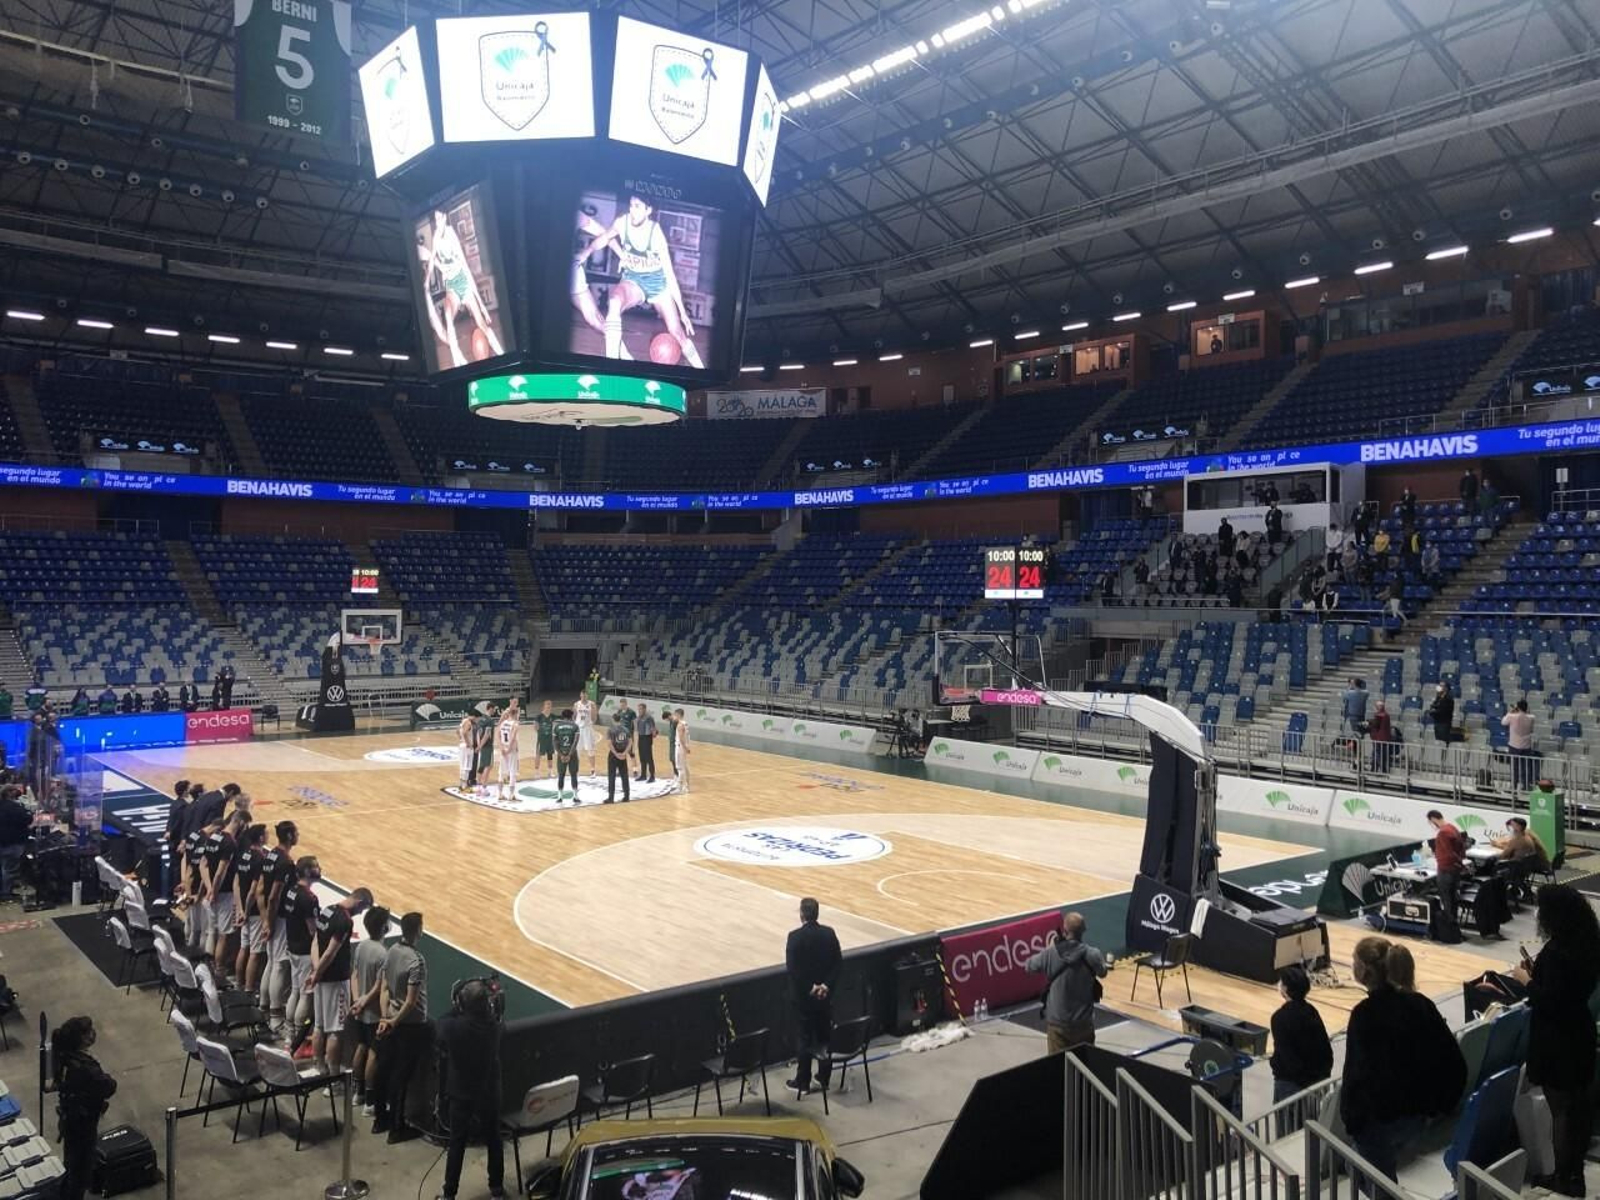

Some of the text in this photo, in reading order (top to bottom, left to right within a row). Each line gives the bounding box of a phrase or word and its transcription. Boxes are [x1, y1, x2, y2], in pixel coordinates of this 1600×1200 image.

[271, 0, 317, 22] BERNI
[274, 24, 314, 89] 5
[268, 115, 290, 128] 1999
[301, 122, 321, 135] 2012
[1518, 429, 1532, 439] Tu
[1534, 423, 1584, 439] segundo
[1545, 438, 1560, 447] en
[1563, 435, 1574, 445] el
[37, 468, 61, 477] lugar
[1169, 461, 1190, 470] lugar
[128, 481, 152, 489] world
[988, 550, 1044, 561] 10:00 10:00
[988, 565, 1041, 588] 24 24
[997, 692, 1037, 705] endesa
[187, 713, 250, 730] endesa
[1287, 802, 1319, 816] Unicaja
[1367, 811, 1402, 825] Unicaja
